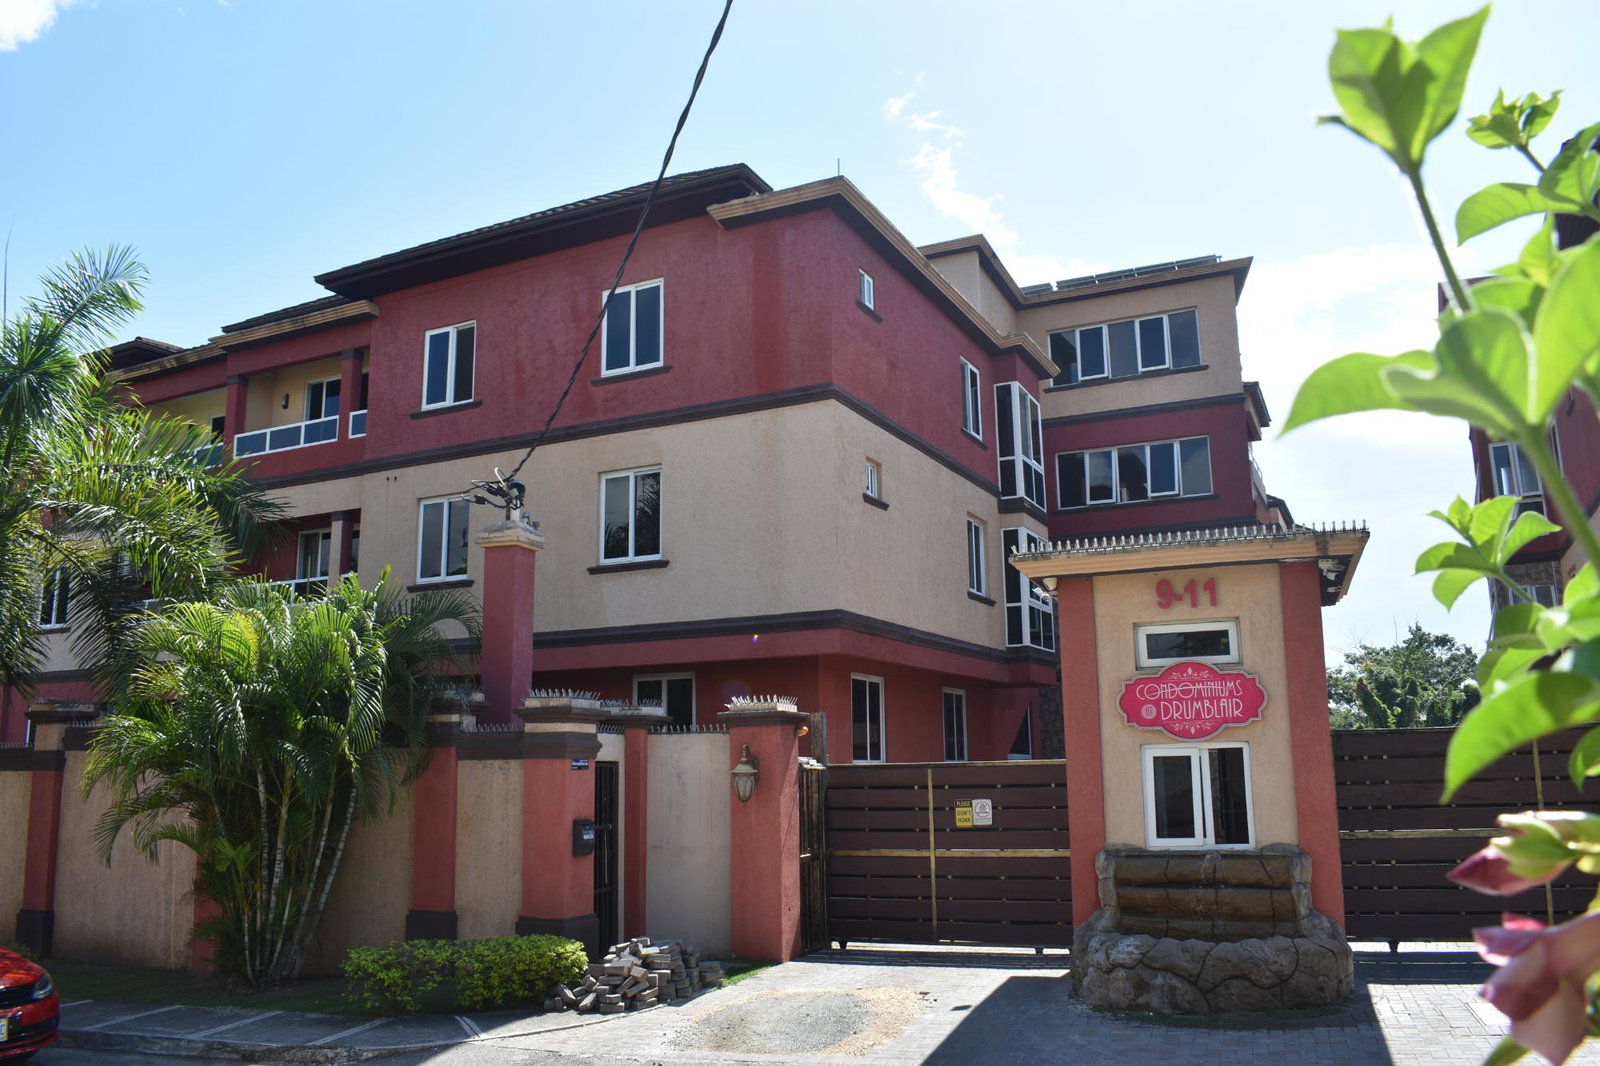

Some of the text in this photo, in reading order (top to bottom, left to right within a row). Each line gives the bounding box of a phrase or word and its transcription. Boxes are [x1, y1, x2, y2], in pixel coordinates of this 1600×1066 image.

[1155, 577, 1217, 610] 9-11
[1136, 680, 1243, 701] CONDOMINIUMS
[1161, 699, 1243, 721] DRUMBLAIR
